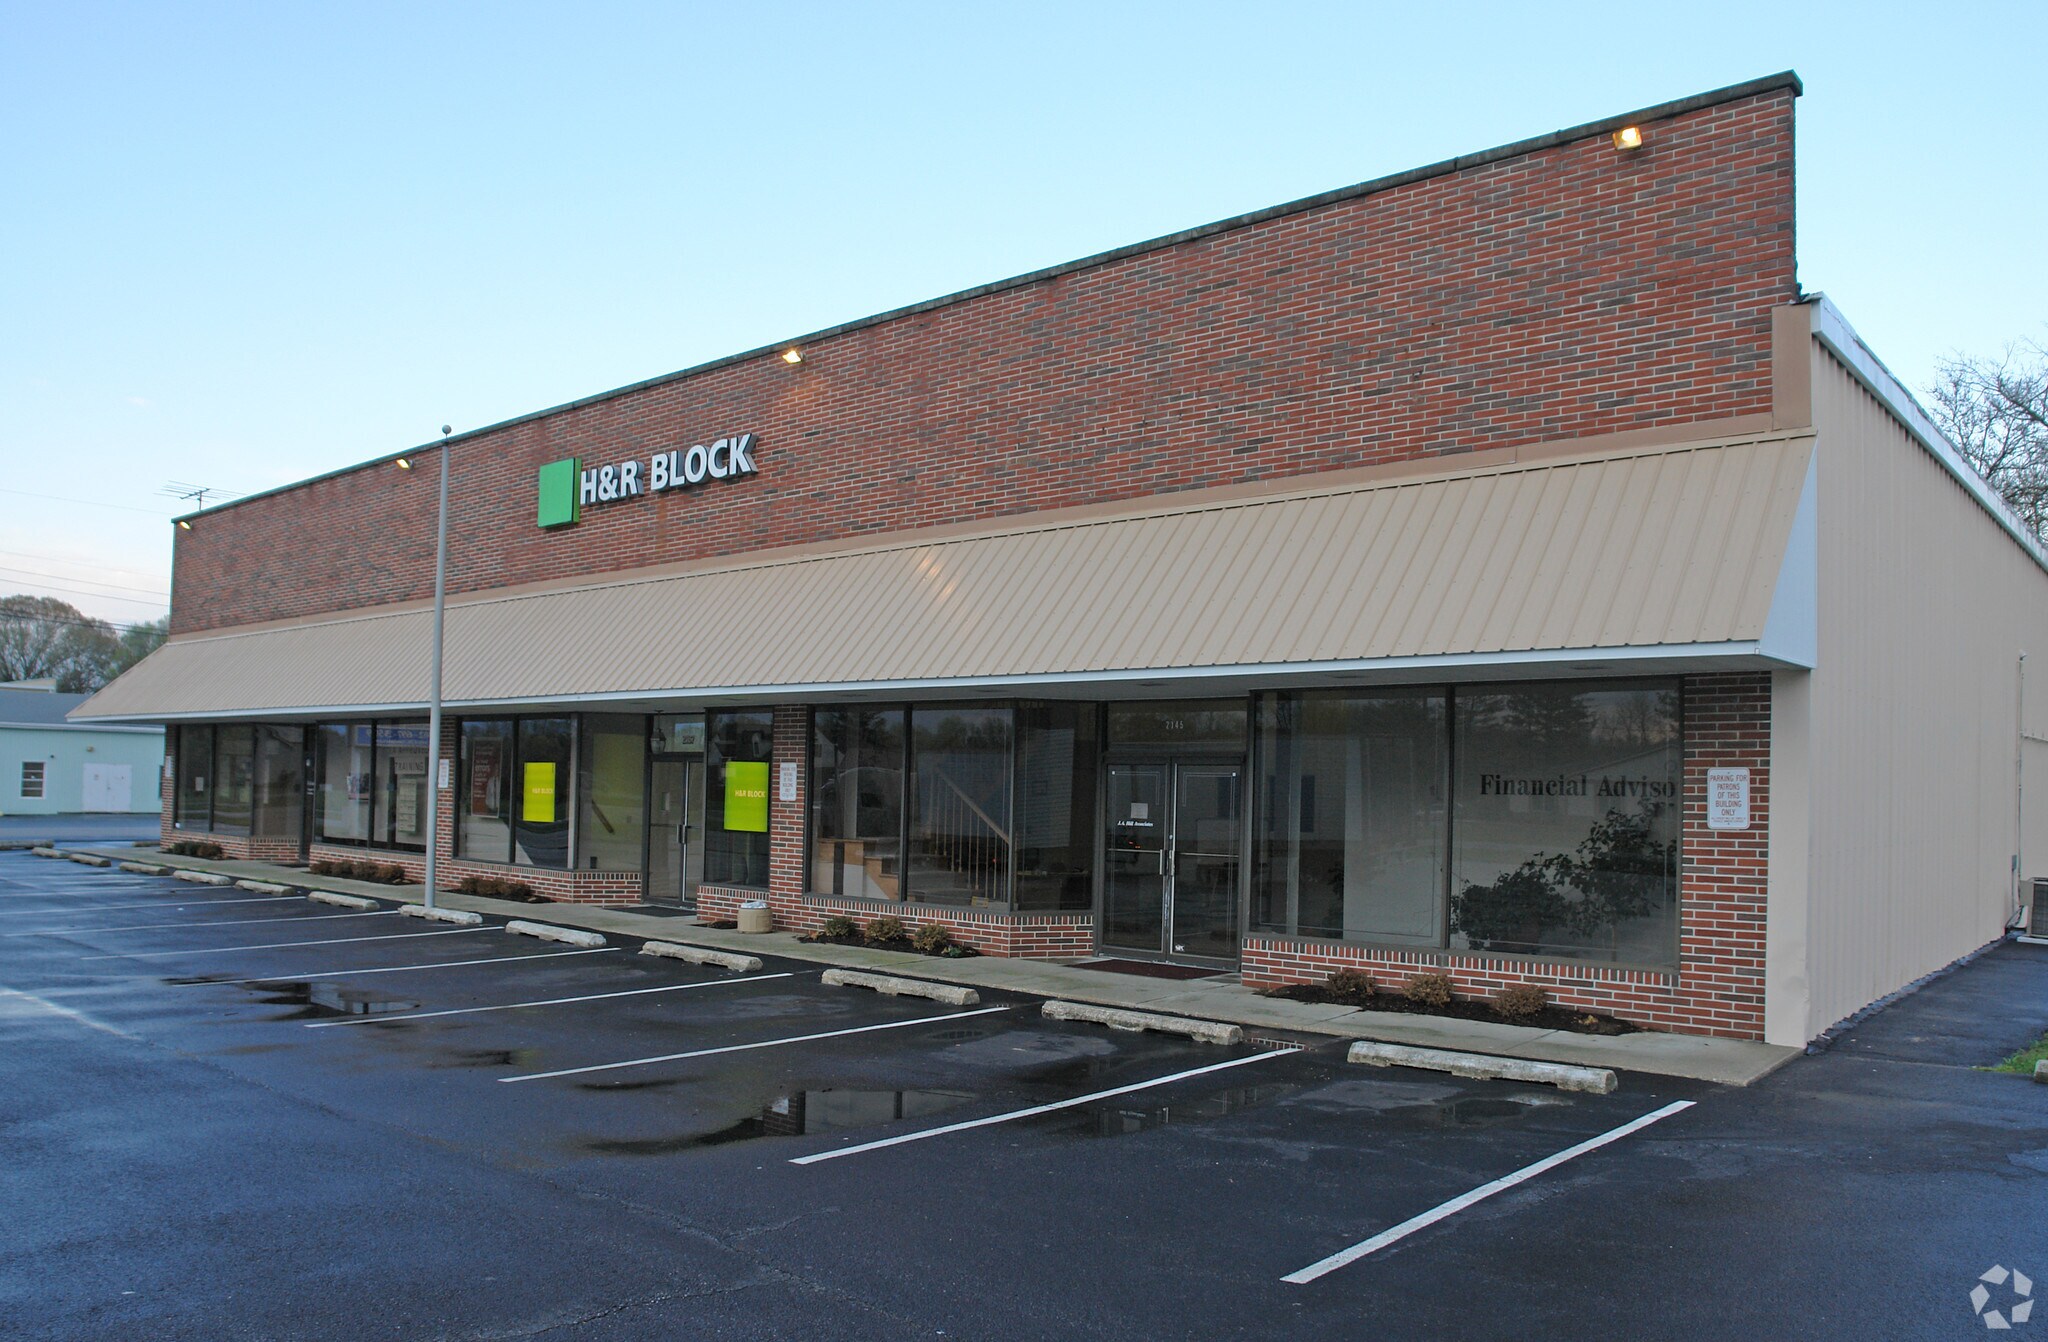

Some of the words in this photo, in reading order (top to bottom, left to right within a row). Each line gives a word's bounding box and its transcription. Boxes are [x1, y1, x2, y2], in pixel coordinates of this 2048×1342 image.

[580, 461, 640, 505] H&R
[650, 433, 757, 491] BLOCK
[1480, 774, 1587, 796] Financial
[734, 789, 746, 797] H&R
[747, 790, 765, 798] BLOCK
[1715, 800, 1742, 808] BUILDING
